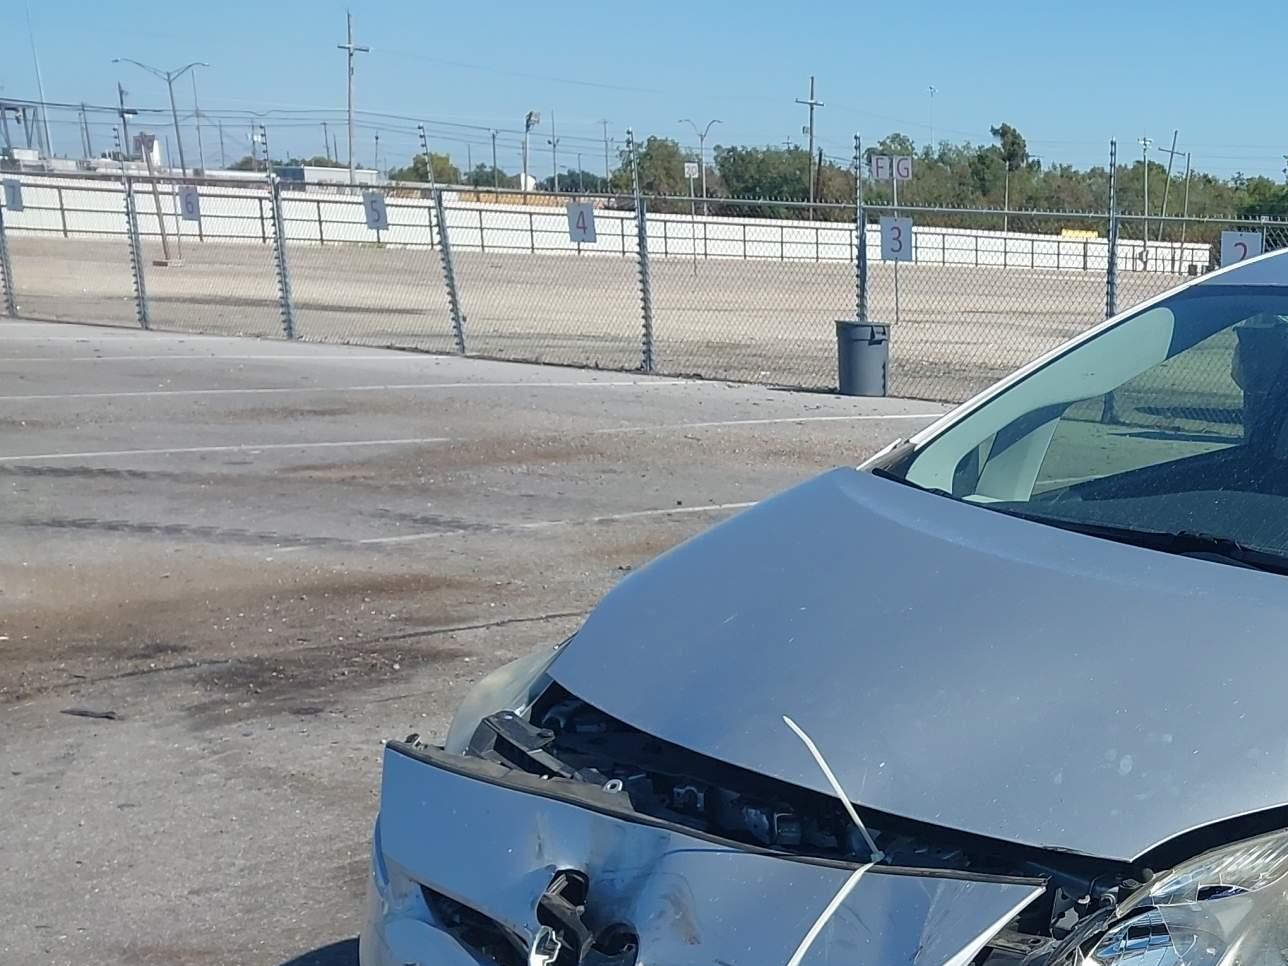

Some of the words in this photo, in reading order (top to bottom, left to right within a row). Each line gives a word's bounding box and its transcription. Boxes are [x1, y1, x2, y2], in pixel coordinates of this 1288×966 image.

[875, 157, 885, 178] F
[897, 157, 910, 178] G
[184, 192, 195, 214] 6
[371, 200, 381, 223] 5
[575, 210, 588, 235] 4
[890, 226, 902, 253] 3
